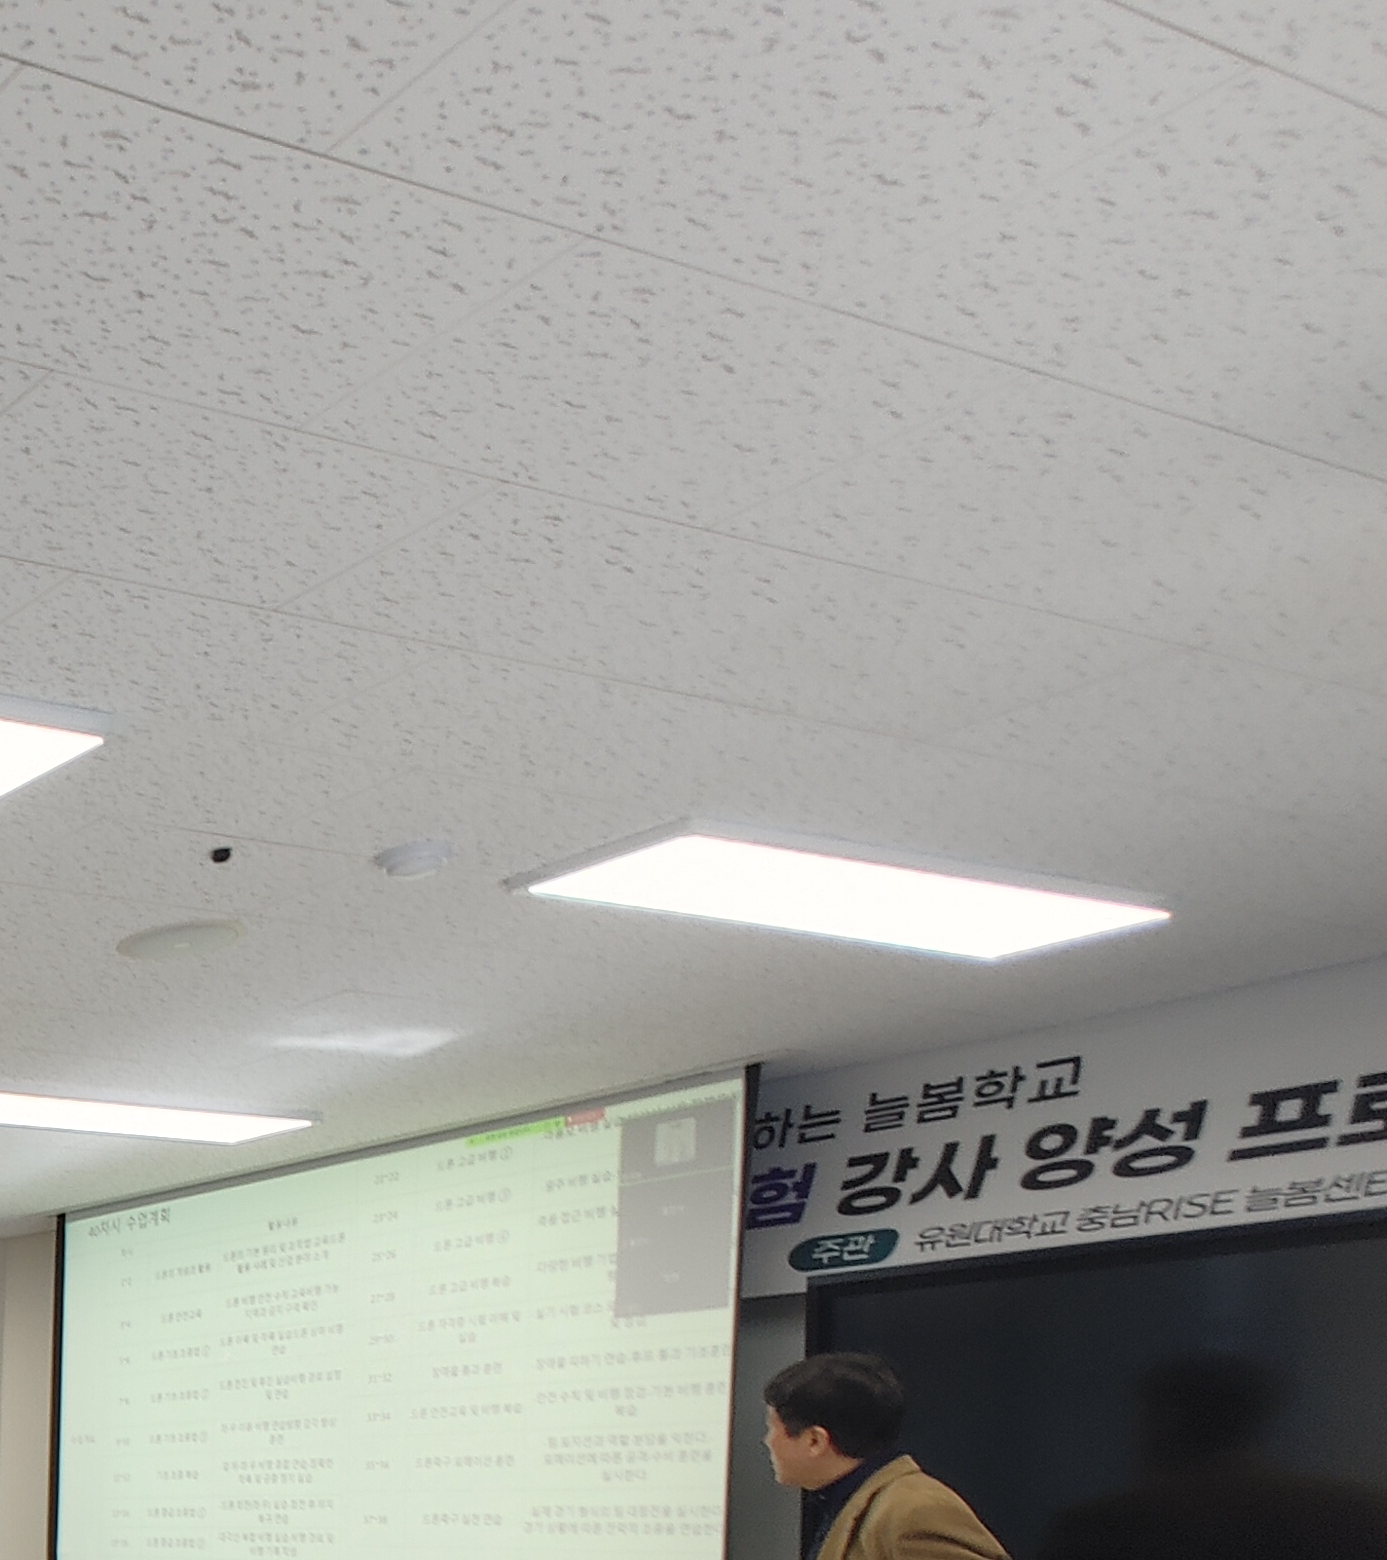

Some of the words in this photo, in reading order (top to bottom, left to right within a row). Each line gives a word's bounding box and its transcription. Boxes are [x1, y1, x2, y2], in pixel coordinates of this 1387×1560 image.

[753, 1105, 841, 1149] 하는
[863, 1056, 1083, 1134] 늘봄학교
[746, 1162, 817, 1230] 험
[837, 1134, 999, 1215] 강사
[1019, 1100, 1208, 1193] 양성
[812, 1234, 877, 1264] 주관
[915, 1211, 1070, 1252] 유원대학교
